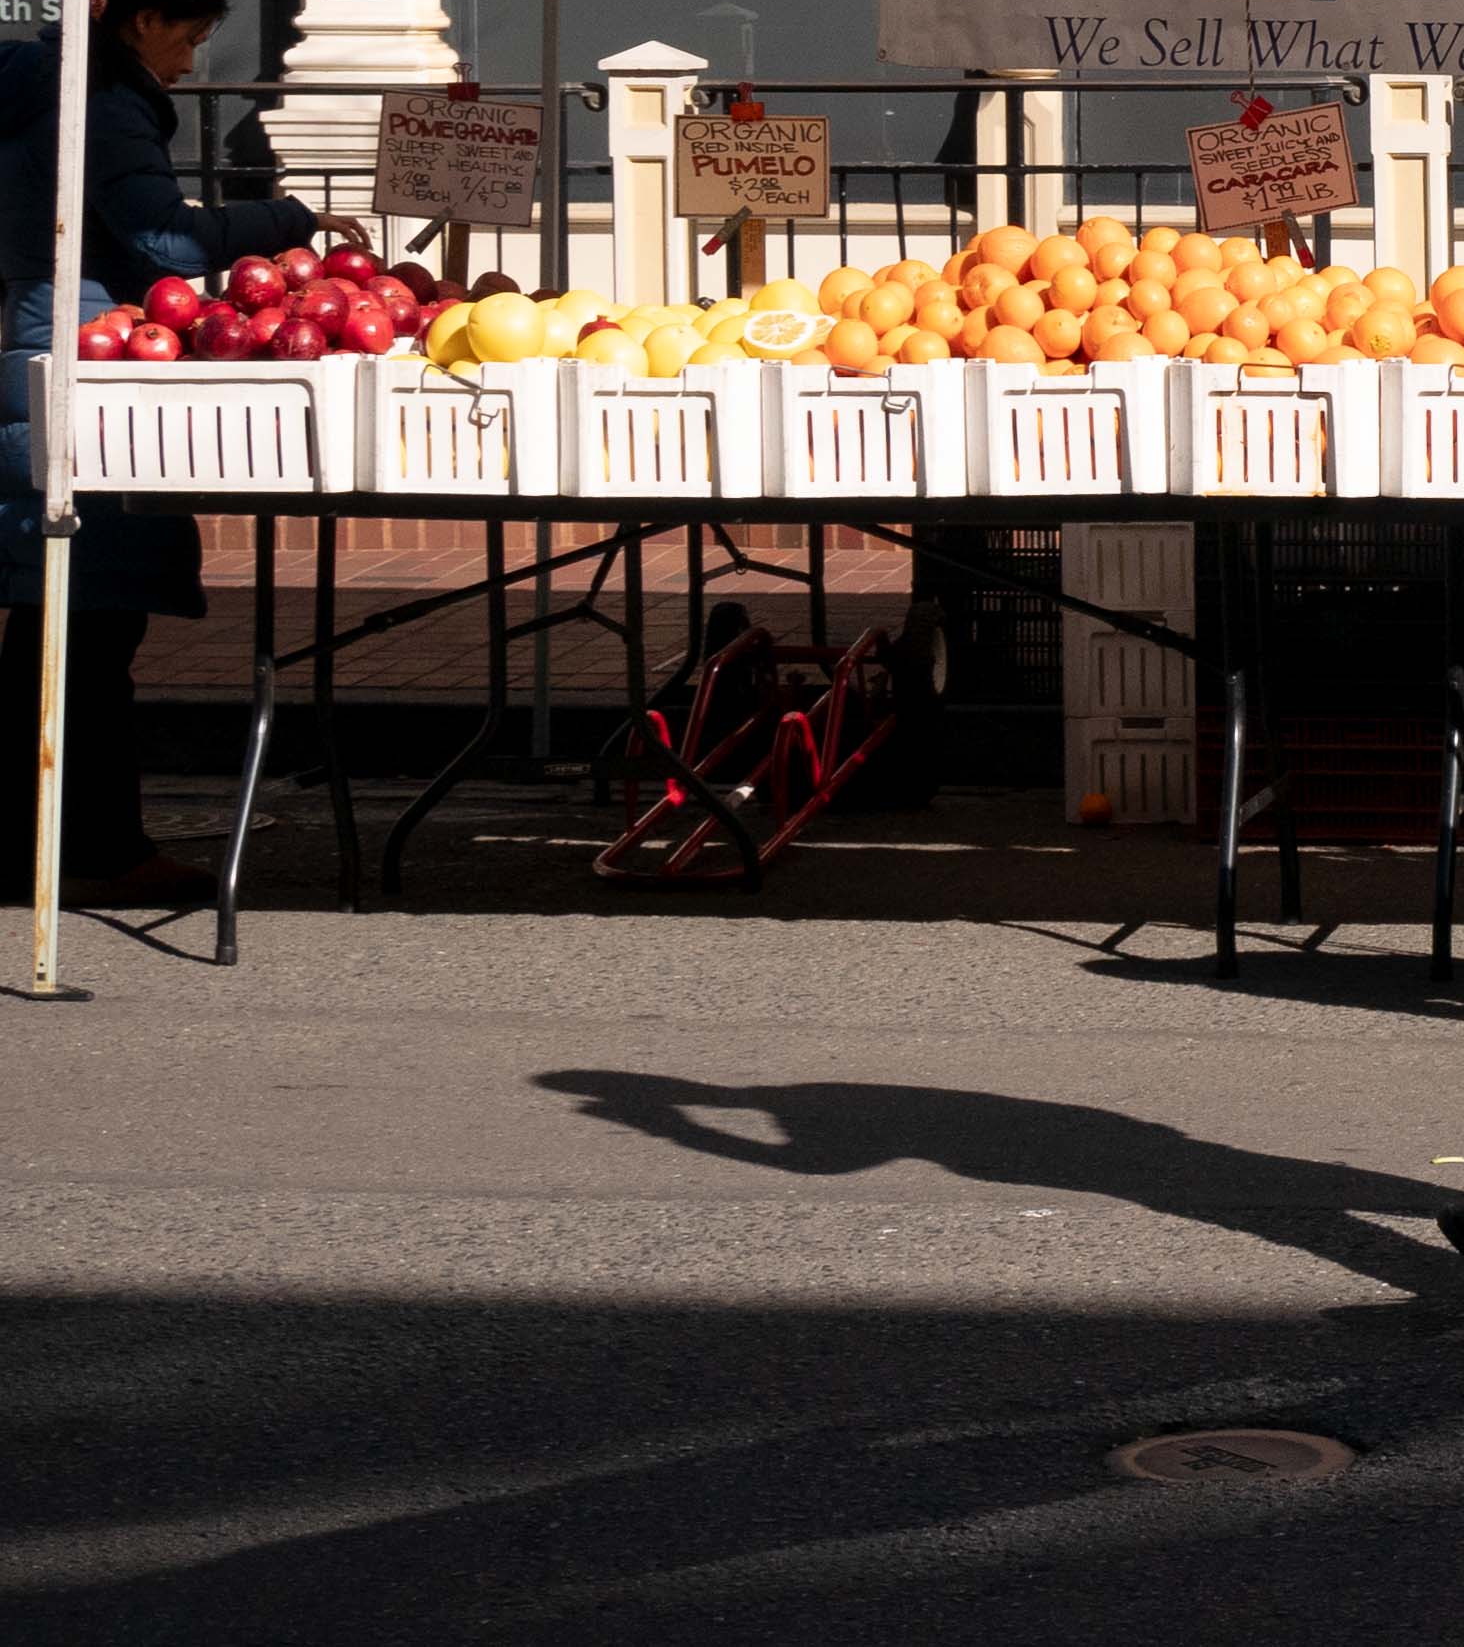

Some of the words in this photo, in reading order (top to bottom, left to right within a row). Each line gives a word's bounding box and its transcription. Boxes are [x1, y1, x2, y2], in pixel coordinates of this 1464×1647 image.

[1045, 14, 1121, 67] We
[1139, 17, 1225, 70] Sell
[1248, 18, 1385, 72] What
[407, 97, 518, 125] ORGANIC
[682, 121, 823, 143] ORGANIC
[1197, 115, 1332, 152] ORGANIC
[385, 137, 445, 155] SUPER
[456, 143, 514, 160] SWEET
[512, 150, 533, 162] AND
[691, 141, 730, 155] RED
[735, 142, 799, 153] INSIDE
[1260, 138, 1312, 157] JUICY
[1315, 132, 1341, 150] AND
[390, 155, 438, 171] VERY
[448, 160, 525, 177] HEALTHY
[691, 155, 816, 178] PUMELO
[1231, 147, 1333, 175] SEEDLESS
[415, 188, 451, 203] EACH
[765, 190, 810, 205] EACH
